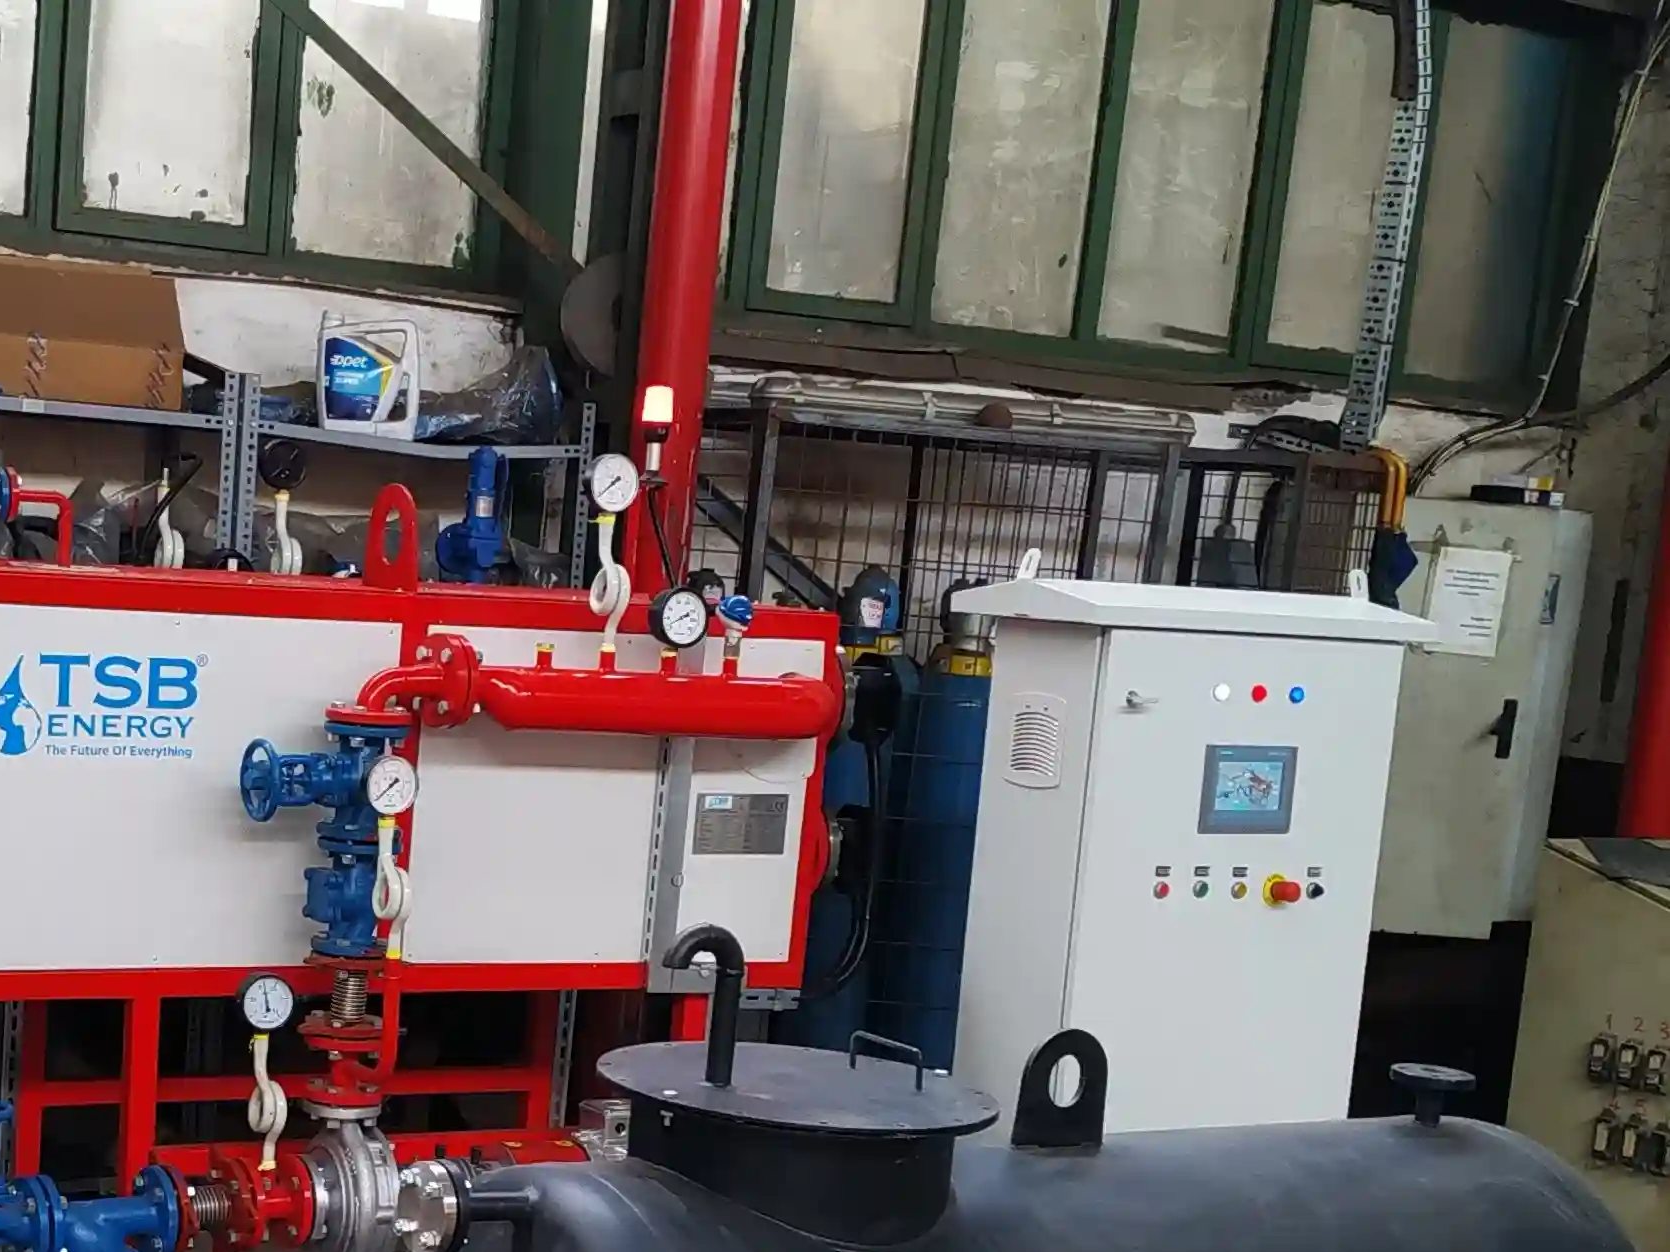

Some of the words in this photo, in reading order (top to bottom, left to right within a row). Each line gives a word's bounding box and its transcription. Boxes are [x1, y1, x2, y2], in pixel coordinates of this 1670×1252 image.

[38, 652, 198, 710] TSB
[47, 714, 194, 739] ENERGY
[45, 745, 68, 756] The
[71, 745, 109, 757] Future
[113, 746, 127, 756] Of
[130, 747, 193, 759] Everything
[1634, 1016, 1645, 1032] 2
